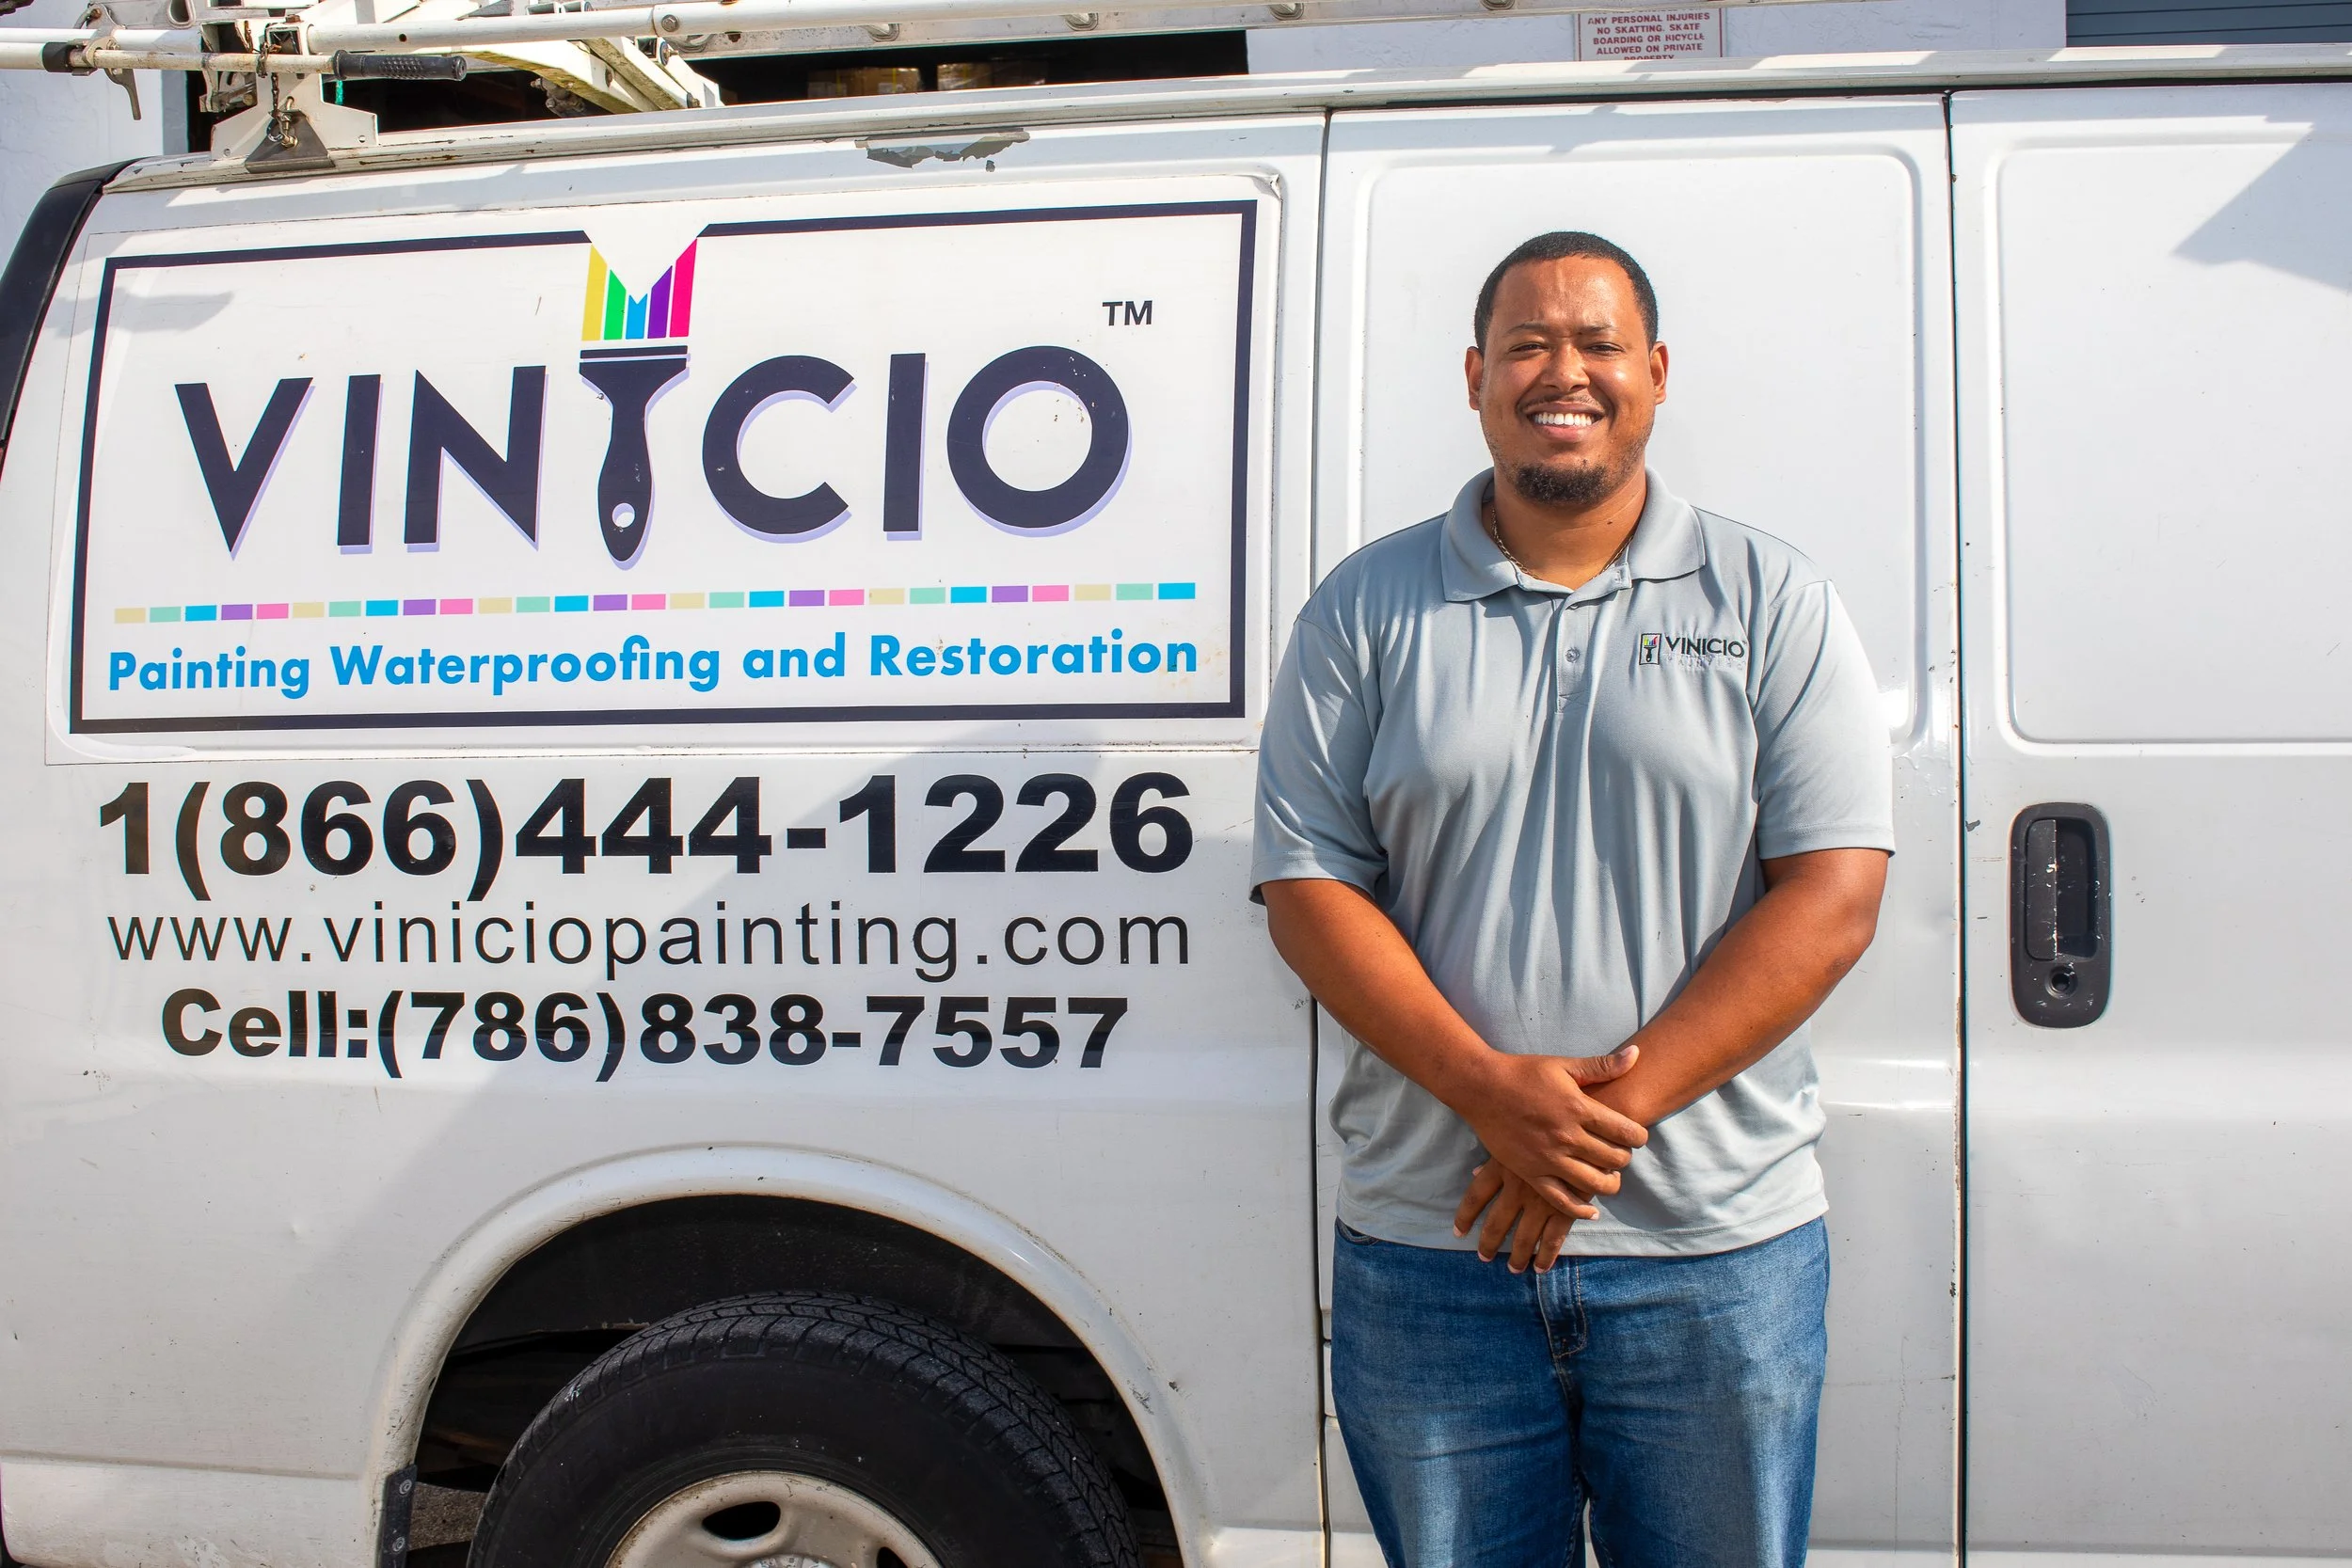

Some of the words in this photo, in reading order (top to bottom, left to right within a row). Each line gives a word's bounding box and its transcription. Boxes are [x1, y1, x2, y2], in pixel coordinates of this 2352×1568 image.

[1612, 15, 1662, 24] PERSONAL
[1666, 12, 1710, 22] INJURIES
[1669, 23, 1700, 31] SKATE
[1593, 36, 1643, 45] BOARDING
[1596, 46, 1642, 55] ALLOWED
[1663, 43, 1703, 52] PRIVATE
[1102, 300, 1153, 326] TM
[1665, 636, 1745, 658] VINICIO
[109, 645, 310, 700] Painting
[329, 634, 720, 697] Waterproofing
[742, 631, 846, 678] and
[870, 628, 1198, 676] Restoration
[99, 772, 1193, 902] 1(866)444-1226
[108, 900, 1189, 983] www.viniciopainting.com
